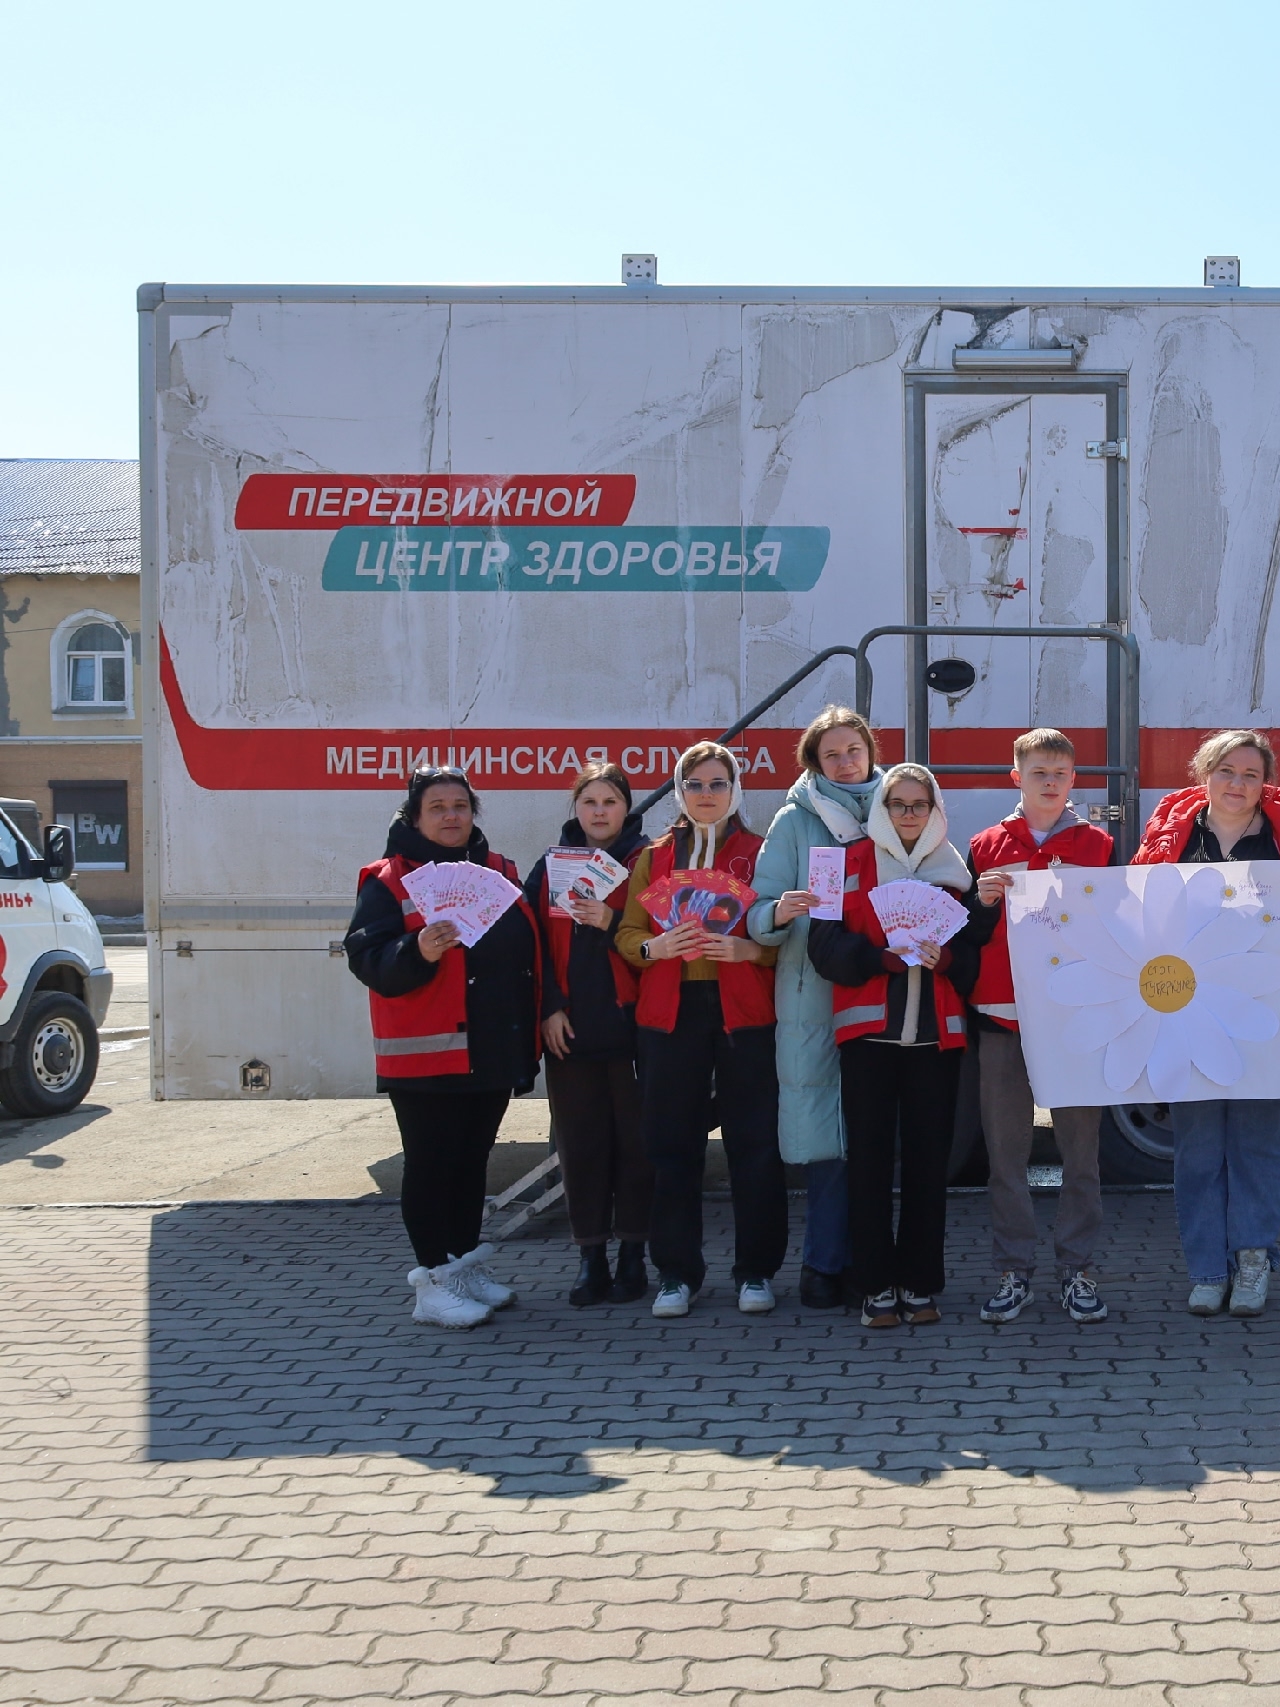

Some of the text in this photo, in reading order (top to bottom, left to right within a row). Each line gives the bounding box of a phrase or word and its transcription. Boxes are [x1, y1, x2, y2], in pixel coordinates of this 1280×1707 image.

[288, 479, 602, 524] ПЕРЕДВИЖНОЙ
[355, 541, 782, 584] ЦЕНТР ЗДОРОВЬЯ
[326, 746, 776, 780] МЕДИЦИНСКАЯ СЛБА
